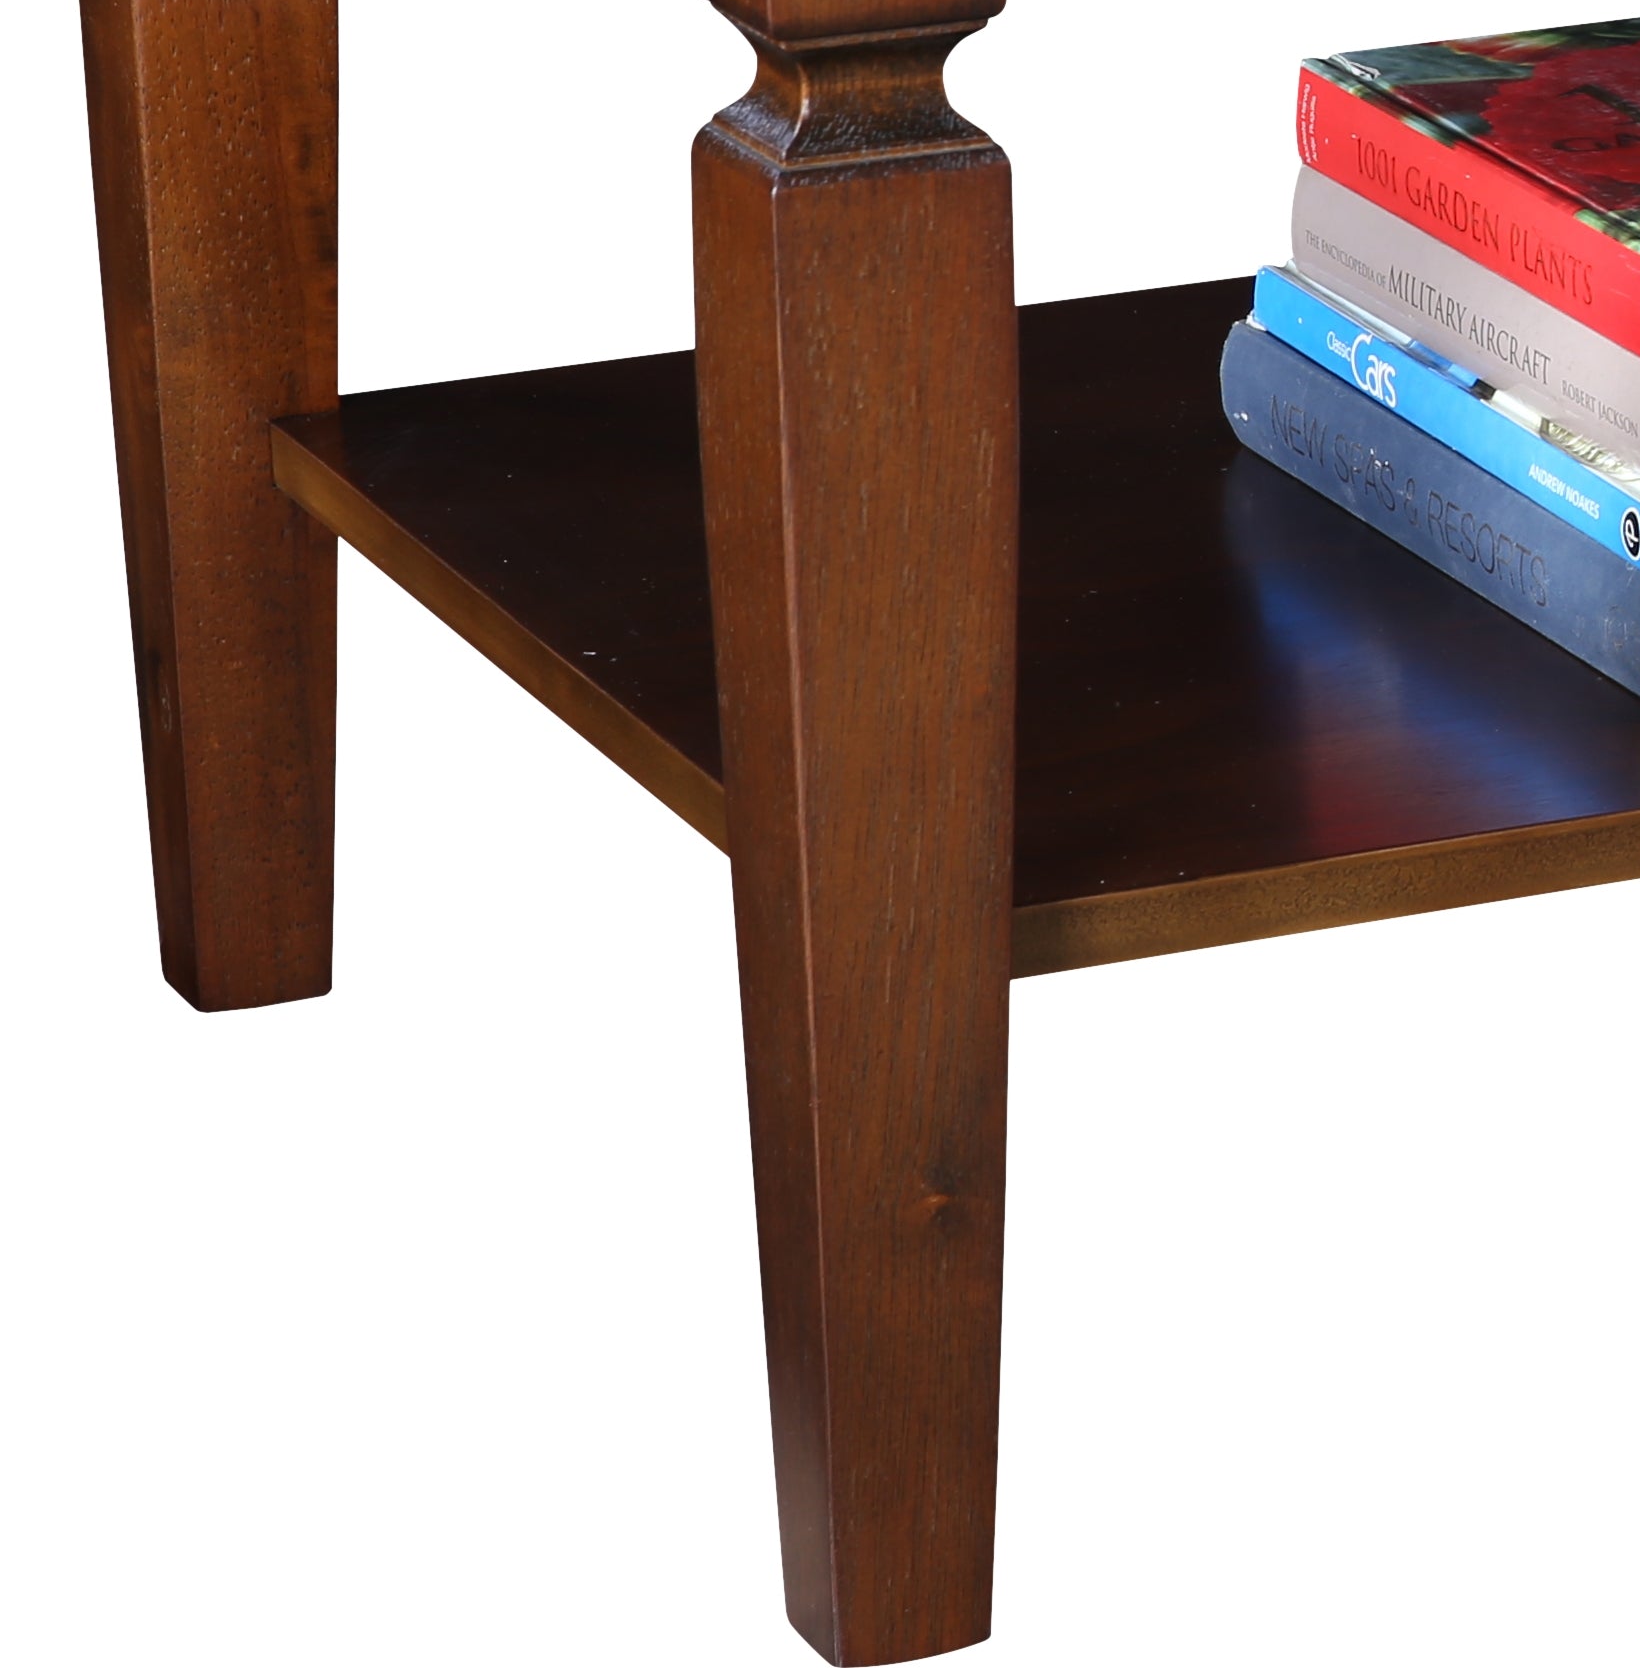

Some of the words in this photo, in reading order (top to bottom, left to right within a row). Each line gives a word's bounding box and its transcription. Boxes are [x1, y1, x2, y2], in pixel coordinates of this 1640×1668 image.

[1356, 137, 1397, 195] 1001
[1404, 166, 1501, 253] GARDEN
[1509, 220, 1594, 305] PLANTS
[1305, 228, 1320, 250] THE
[1320, 238, 1376, 283] ENCYCLOPEDIA
[1375, 271, 1387, 289] OF
[1388, 264, 1468, 334] MILITARY
[1468, 313, 1552, 386] AIRCRAFT
[1326, 330, 1352, 363] Classic
[1350, 332, 1397, 408] Cars
[1561, 379, 1596, 413] ROBERT
[1598, 400, 1639, 438] JACKSON
[1270, 393, 1327, 468] NEW
[1333, 433, 1397, 513] SPAS
[1427, 489, 1548, 609] RESORTS
[1528, 462, 1567, 497] ANDREW
[1565, 485, 1601, 520] NOAKES
